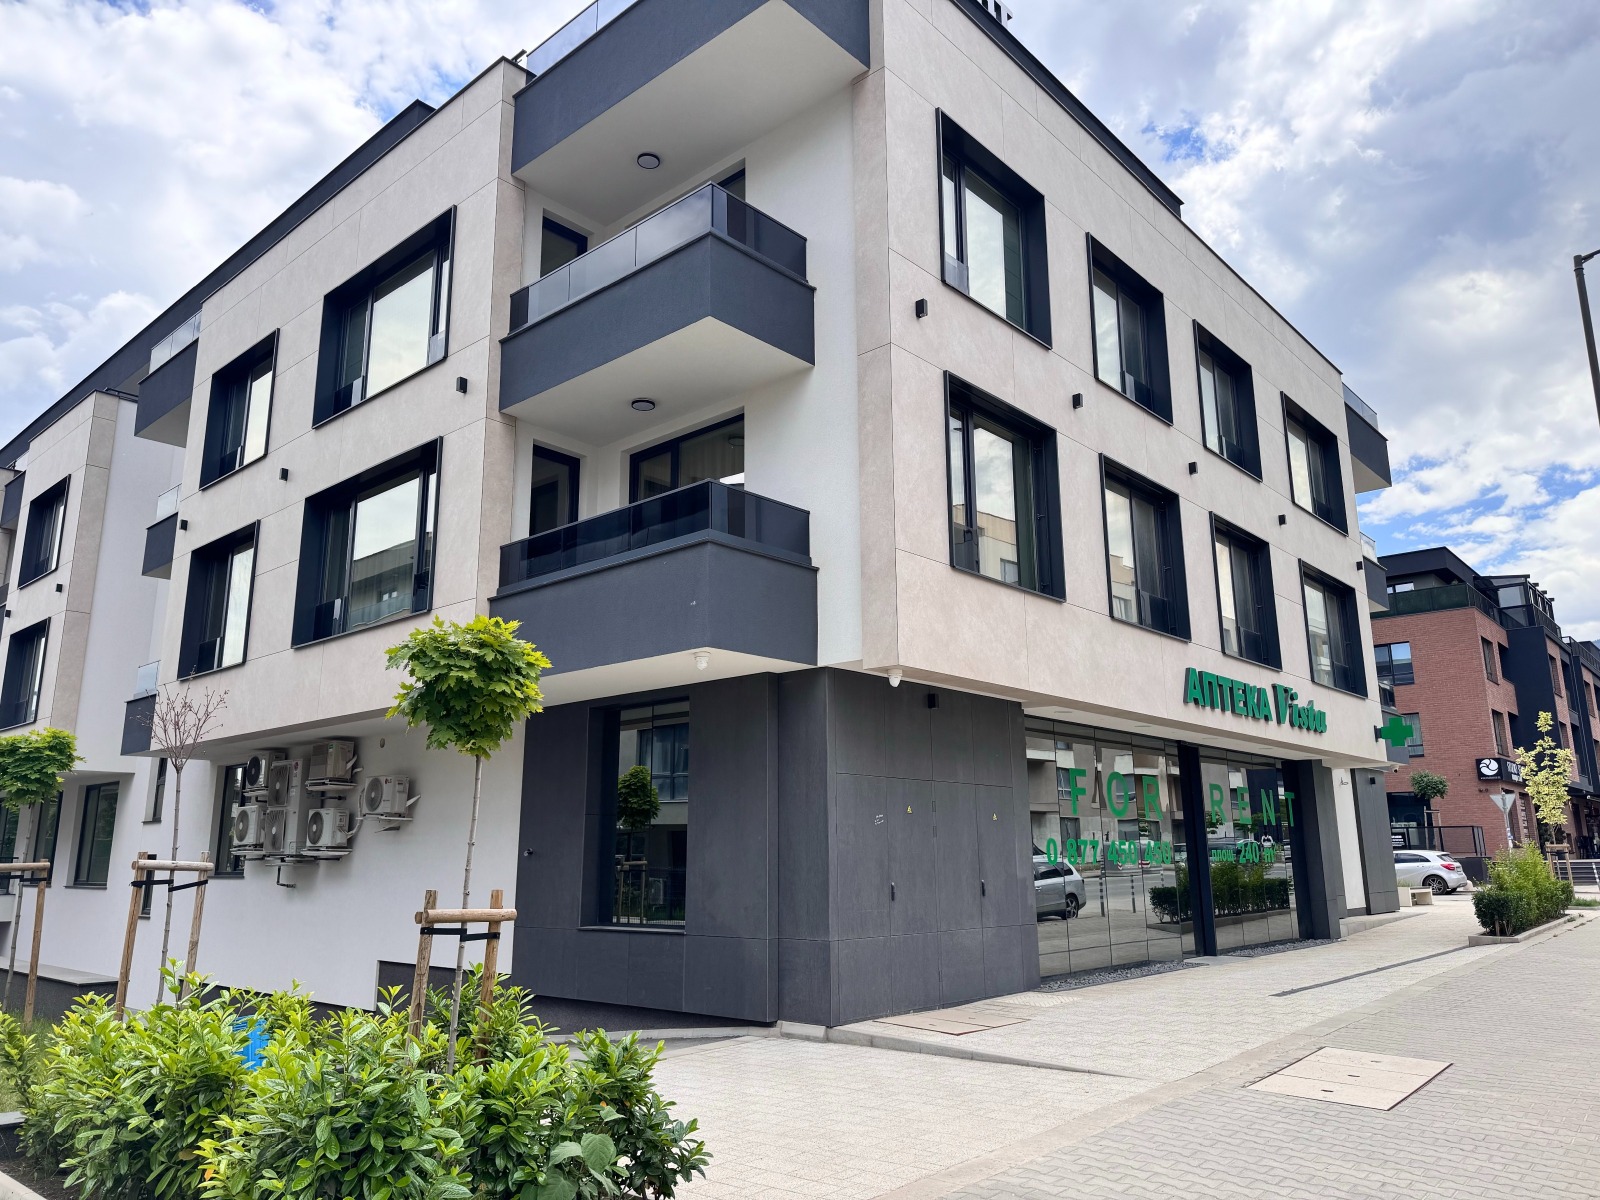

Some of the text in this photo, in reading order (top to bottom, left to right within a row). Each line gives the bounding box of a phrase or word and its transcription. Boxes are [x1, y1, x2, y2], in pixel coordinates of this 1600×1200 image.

[1183, 667, 1328, 734] АПТЕКА Vista
[1069, 768, 1295, 827] FOR RENT
[1046, 838, 1171, 866] 0 877 450 450
[1237, 841, 1260, 864] 240
